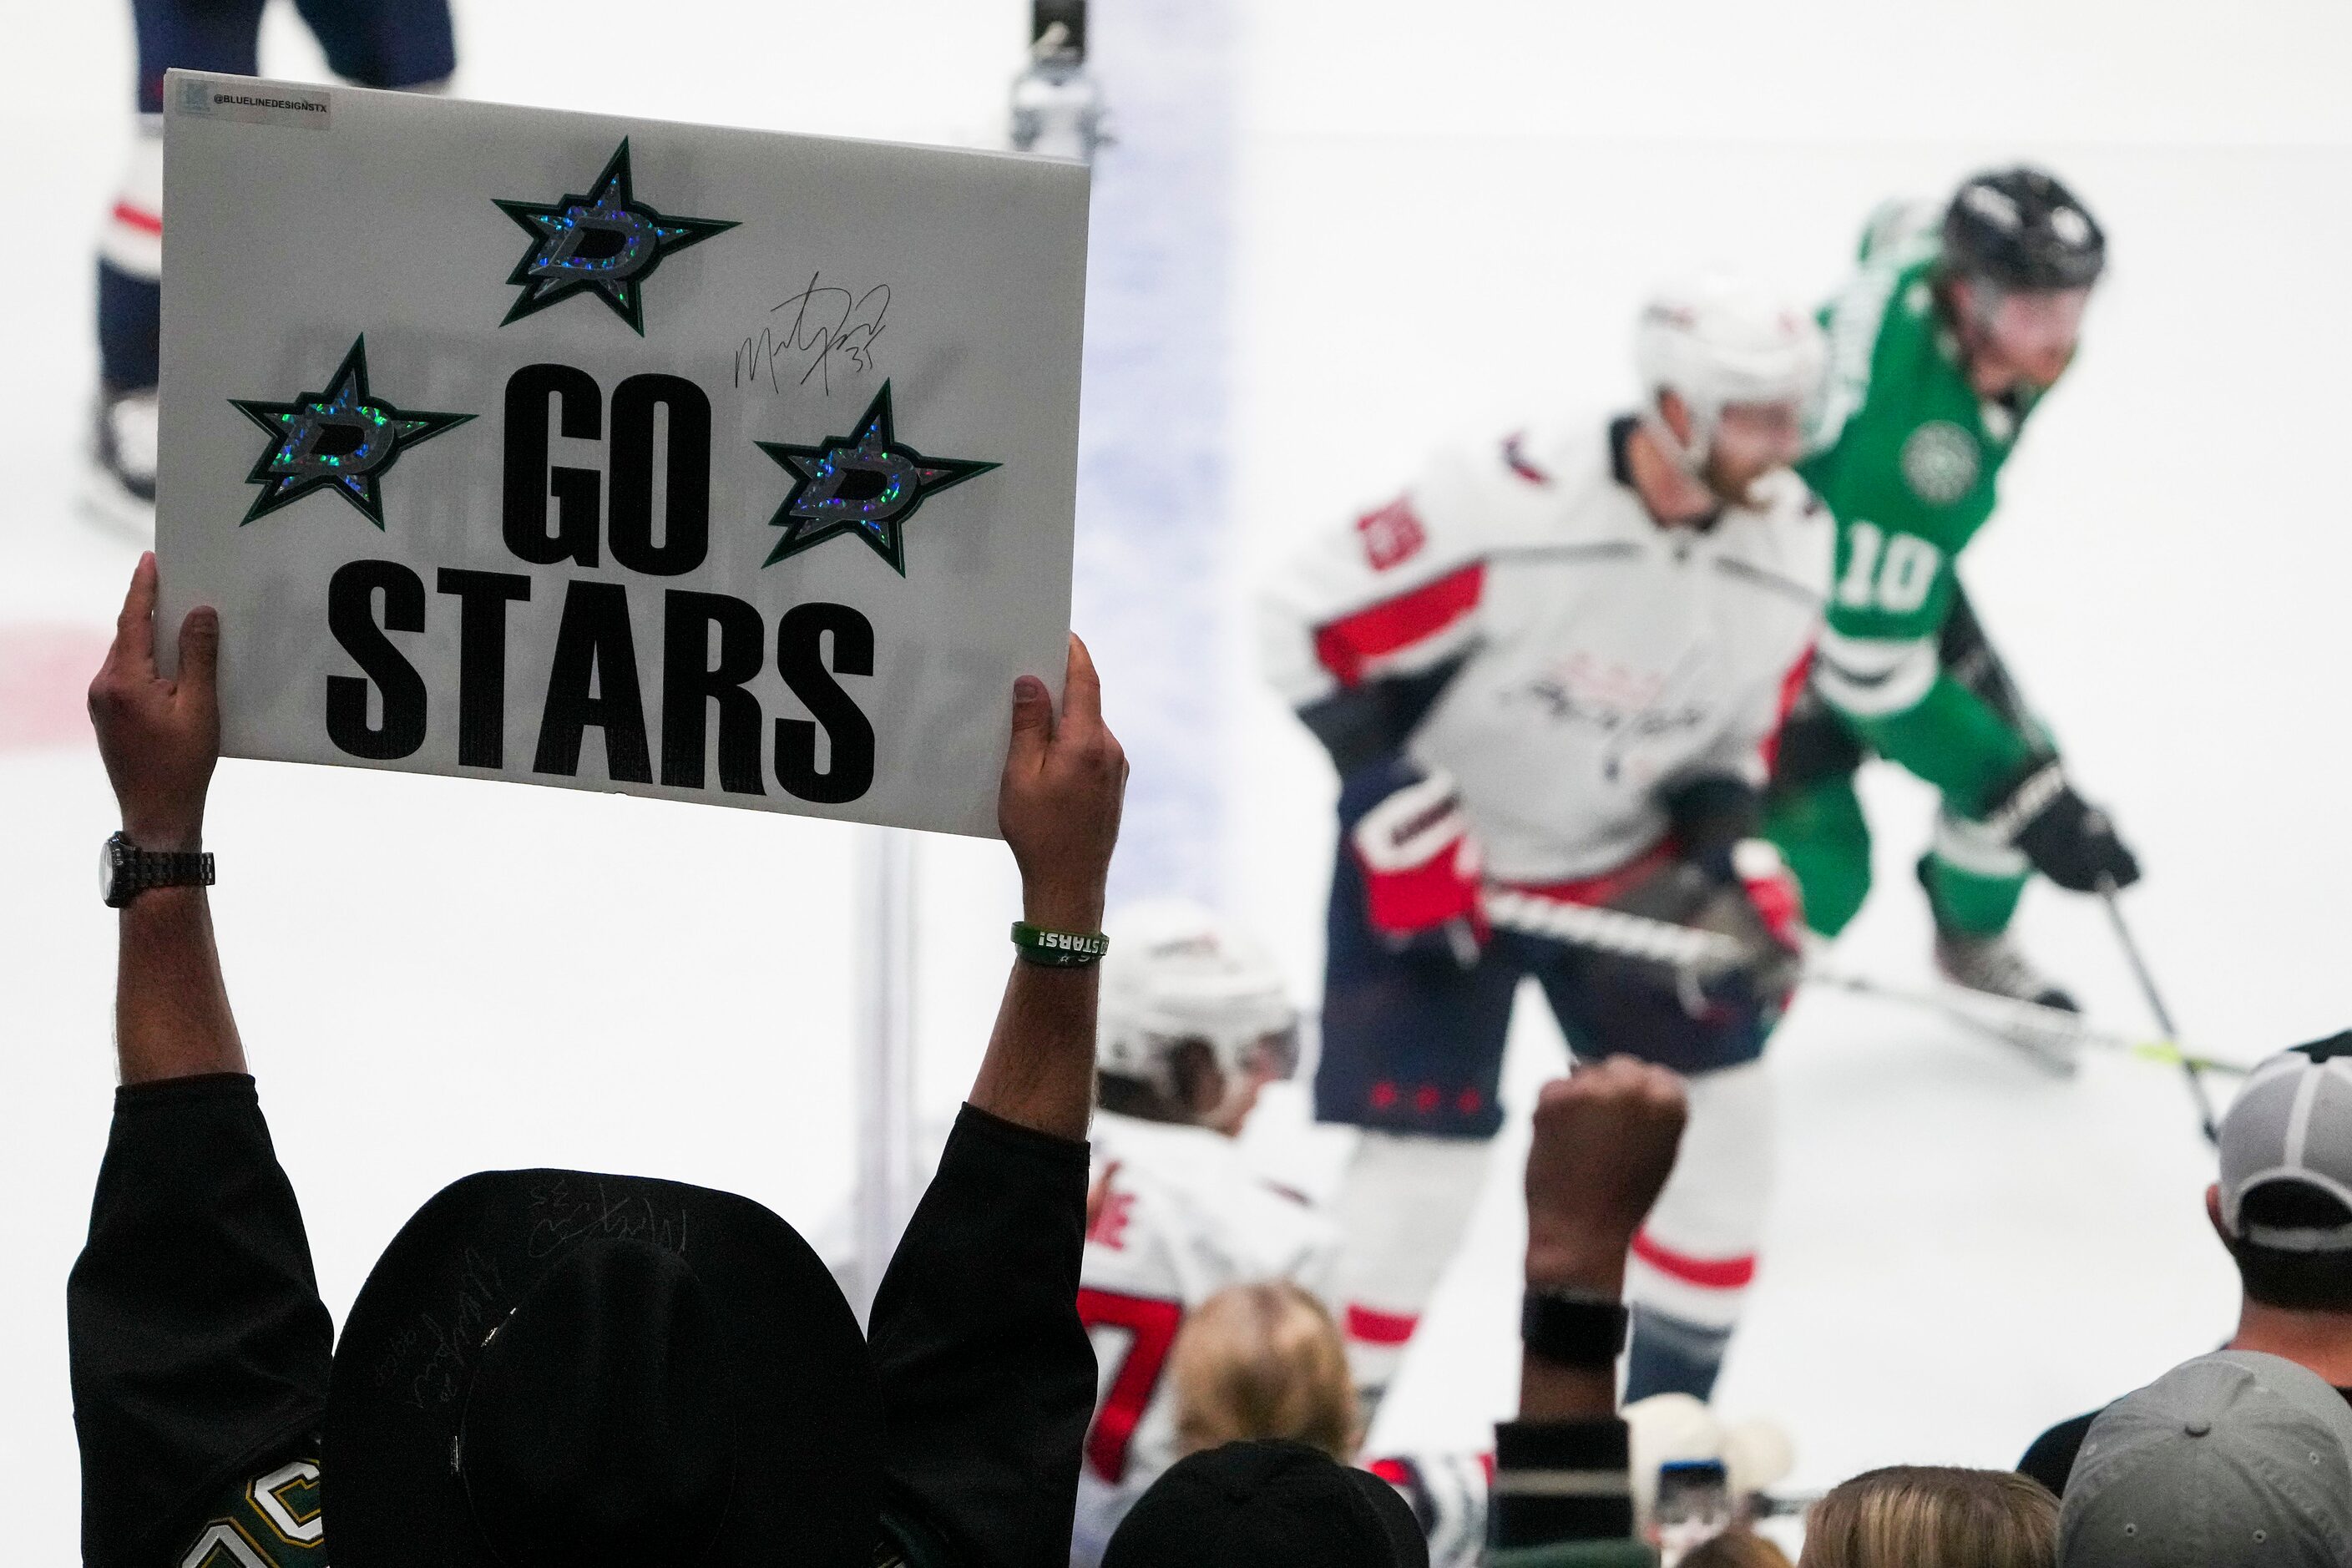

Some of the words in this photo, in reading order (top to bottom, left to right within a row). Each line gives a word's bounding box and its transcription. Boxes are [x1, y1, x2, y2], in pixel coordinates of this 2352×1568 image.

[213, 94, 327, 113] @BLUELINEDESIGNSTX
[502, 363, 711, 576] GO
[1839, 519, 1940, 614] 10
[326, 559, 875, 804] STARS
[1038, 931, 1100, 953] STARS!
